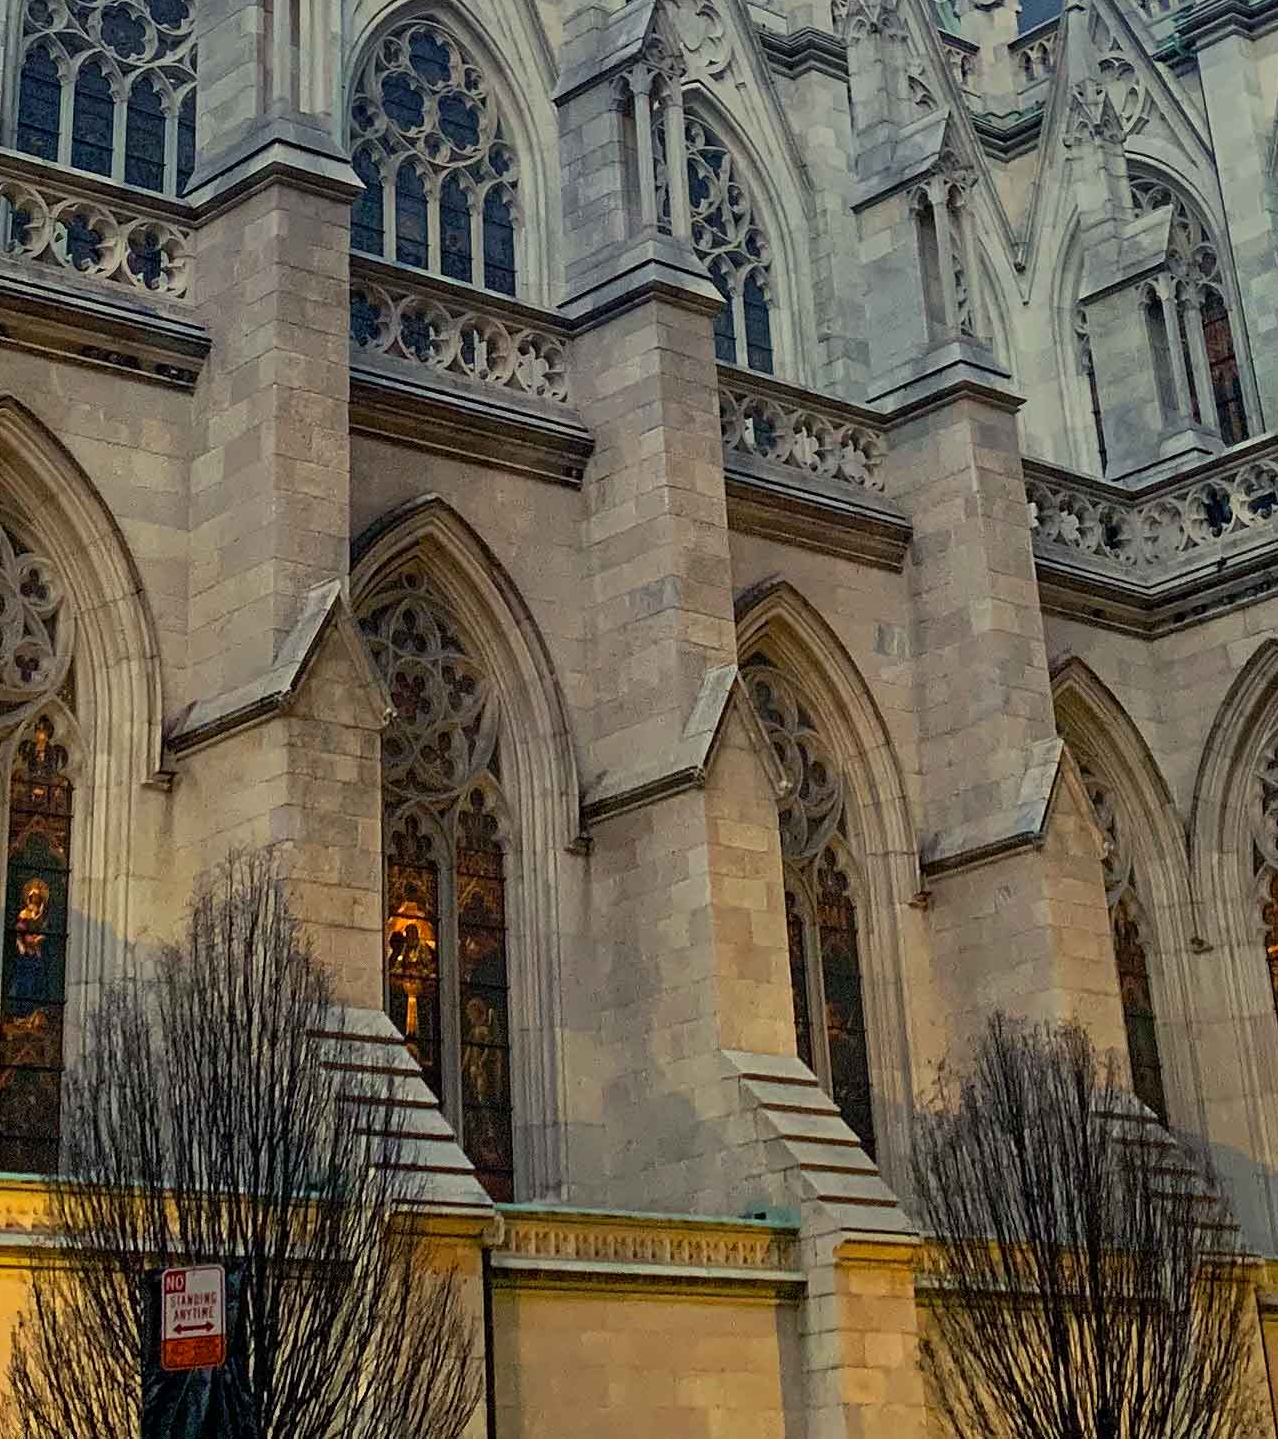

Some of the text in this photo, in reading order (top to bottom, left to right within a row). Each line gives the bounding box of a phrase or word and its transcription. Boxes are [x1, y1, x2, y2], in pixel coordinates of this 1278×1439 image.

[166, 1275, 184, 1291] NO
[171, 1292, 217, 1308] STANDING
[174, 1307, 215, 1322] ANYTIME
